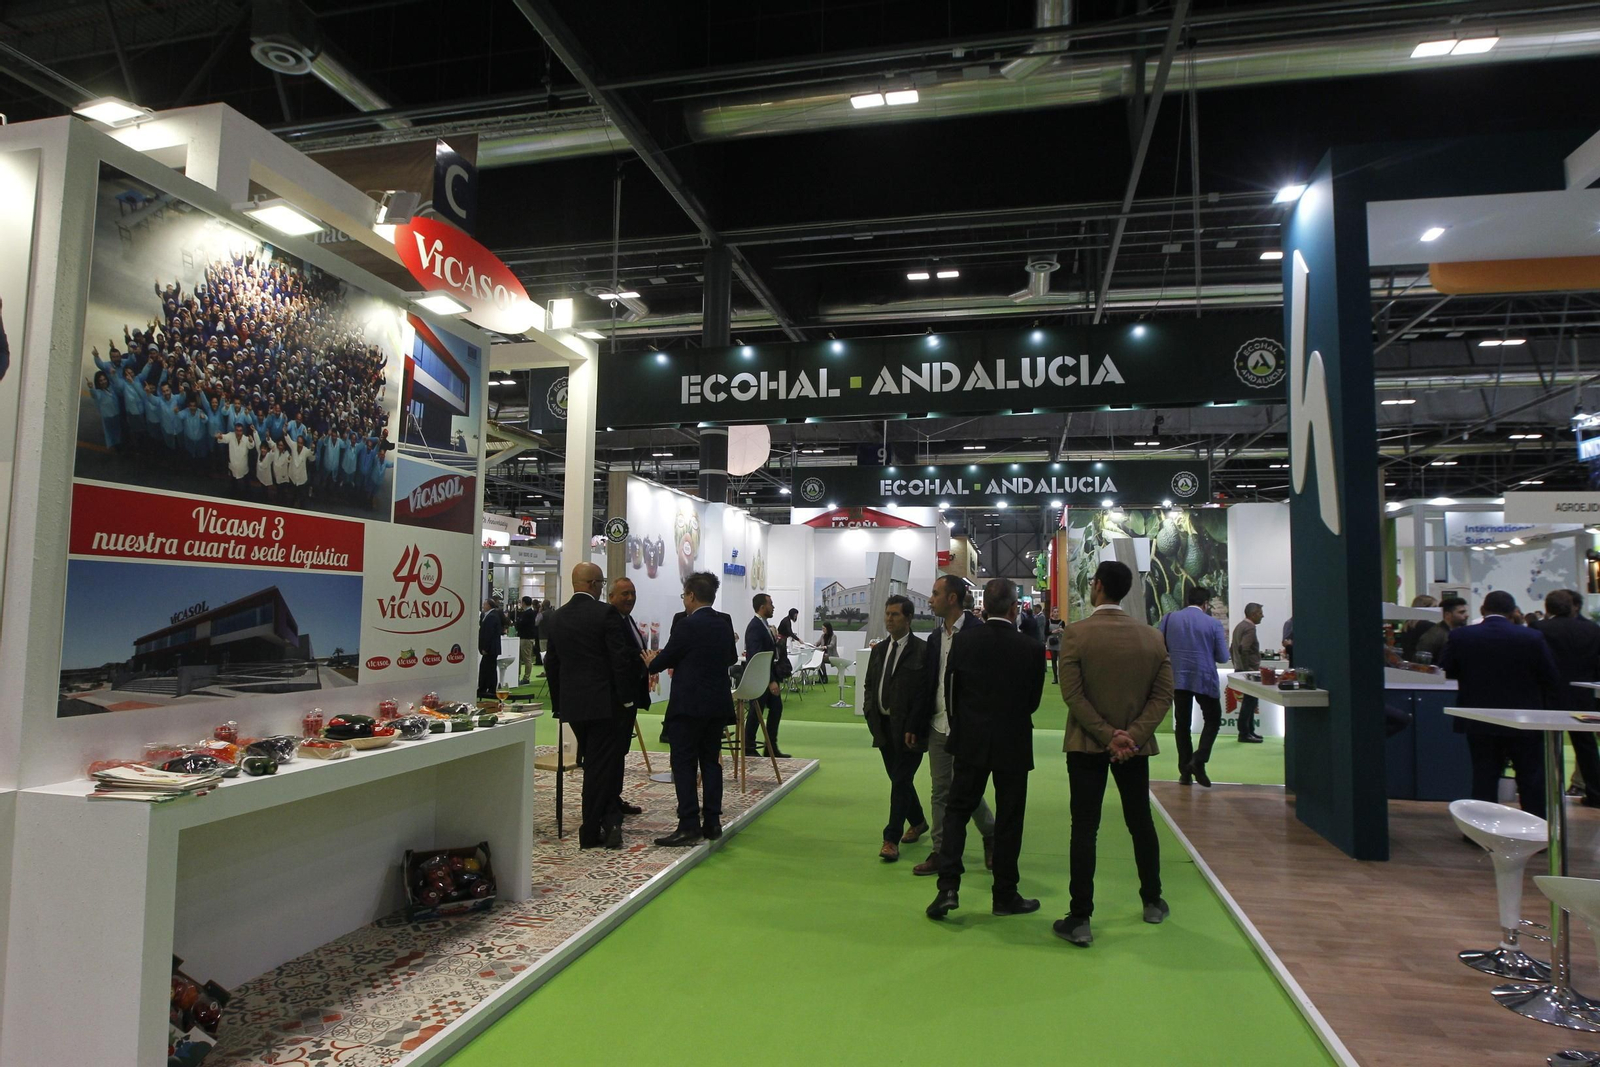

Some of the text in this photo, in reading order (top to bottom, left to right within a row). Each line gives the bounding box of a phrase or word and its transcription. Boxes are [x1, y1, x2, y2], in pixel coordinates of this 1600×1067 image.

[445, 164, 469, 219] C
[1242, 342, 1278, 357] ECOHAL
[553, 380, 569, 393] ECO
[681, 353, 1126, 405] ECOHAL ANDALUCIA
[1241, 368, 1284, 384] ANDALUCIA
[877, 447, 888, 465] 9
[880, 476, 1118, 496] ECOHAL ANDALUCIA
[192, 506, 285, 541] Vicasol 3
[91, 531, 349, 570] nuestra cuarta sede logística
[393, 543, 442, 600] 40
